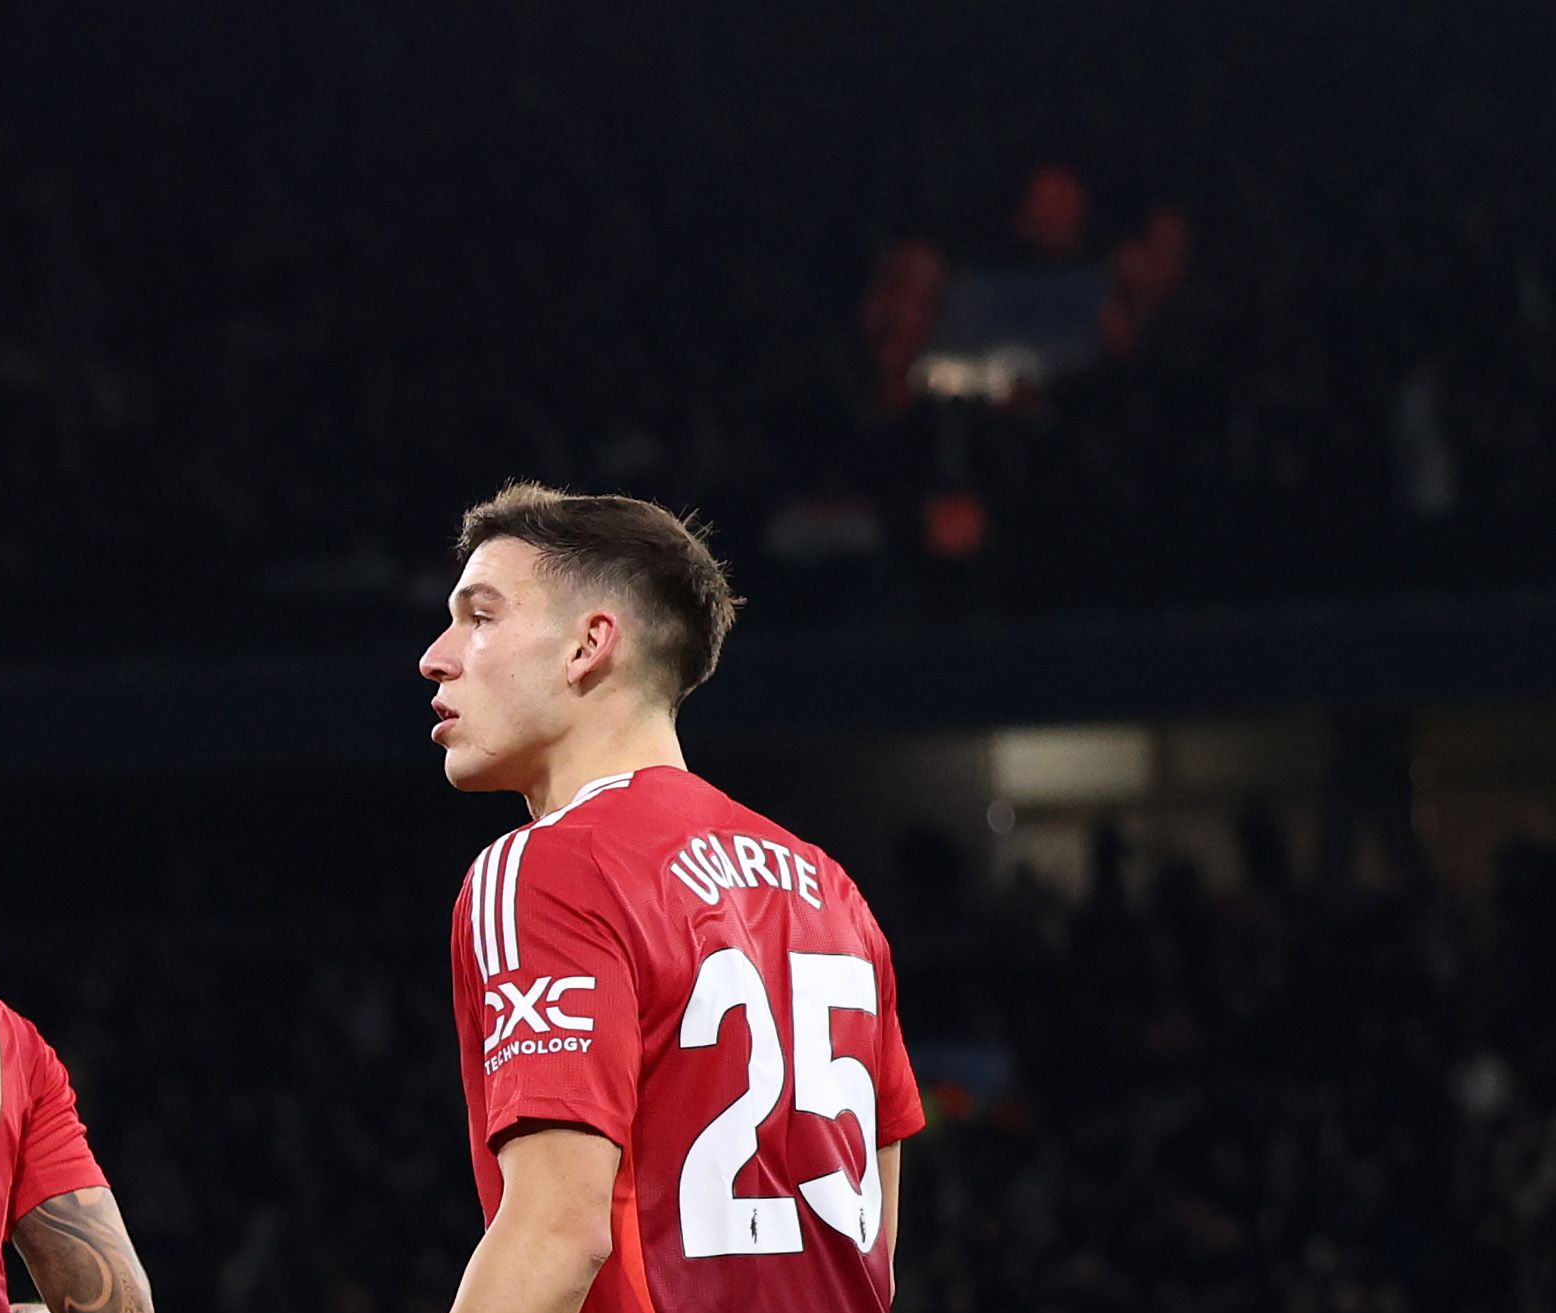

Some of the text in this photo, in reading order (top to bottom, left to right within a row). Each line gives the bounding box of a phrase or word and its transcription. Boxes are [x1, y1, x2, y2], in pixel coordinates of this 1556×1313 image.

[670, 834, 823, 910] UGARTE
[485, 1036, 592, 1076] TECHNOLOGY
[678, 946, 884, 1258] 25
